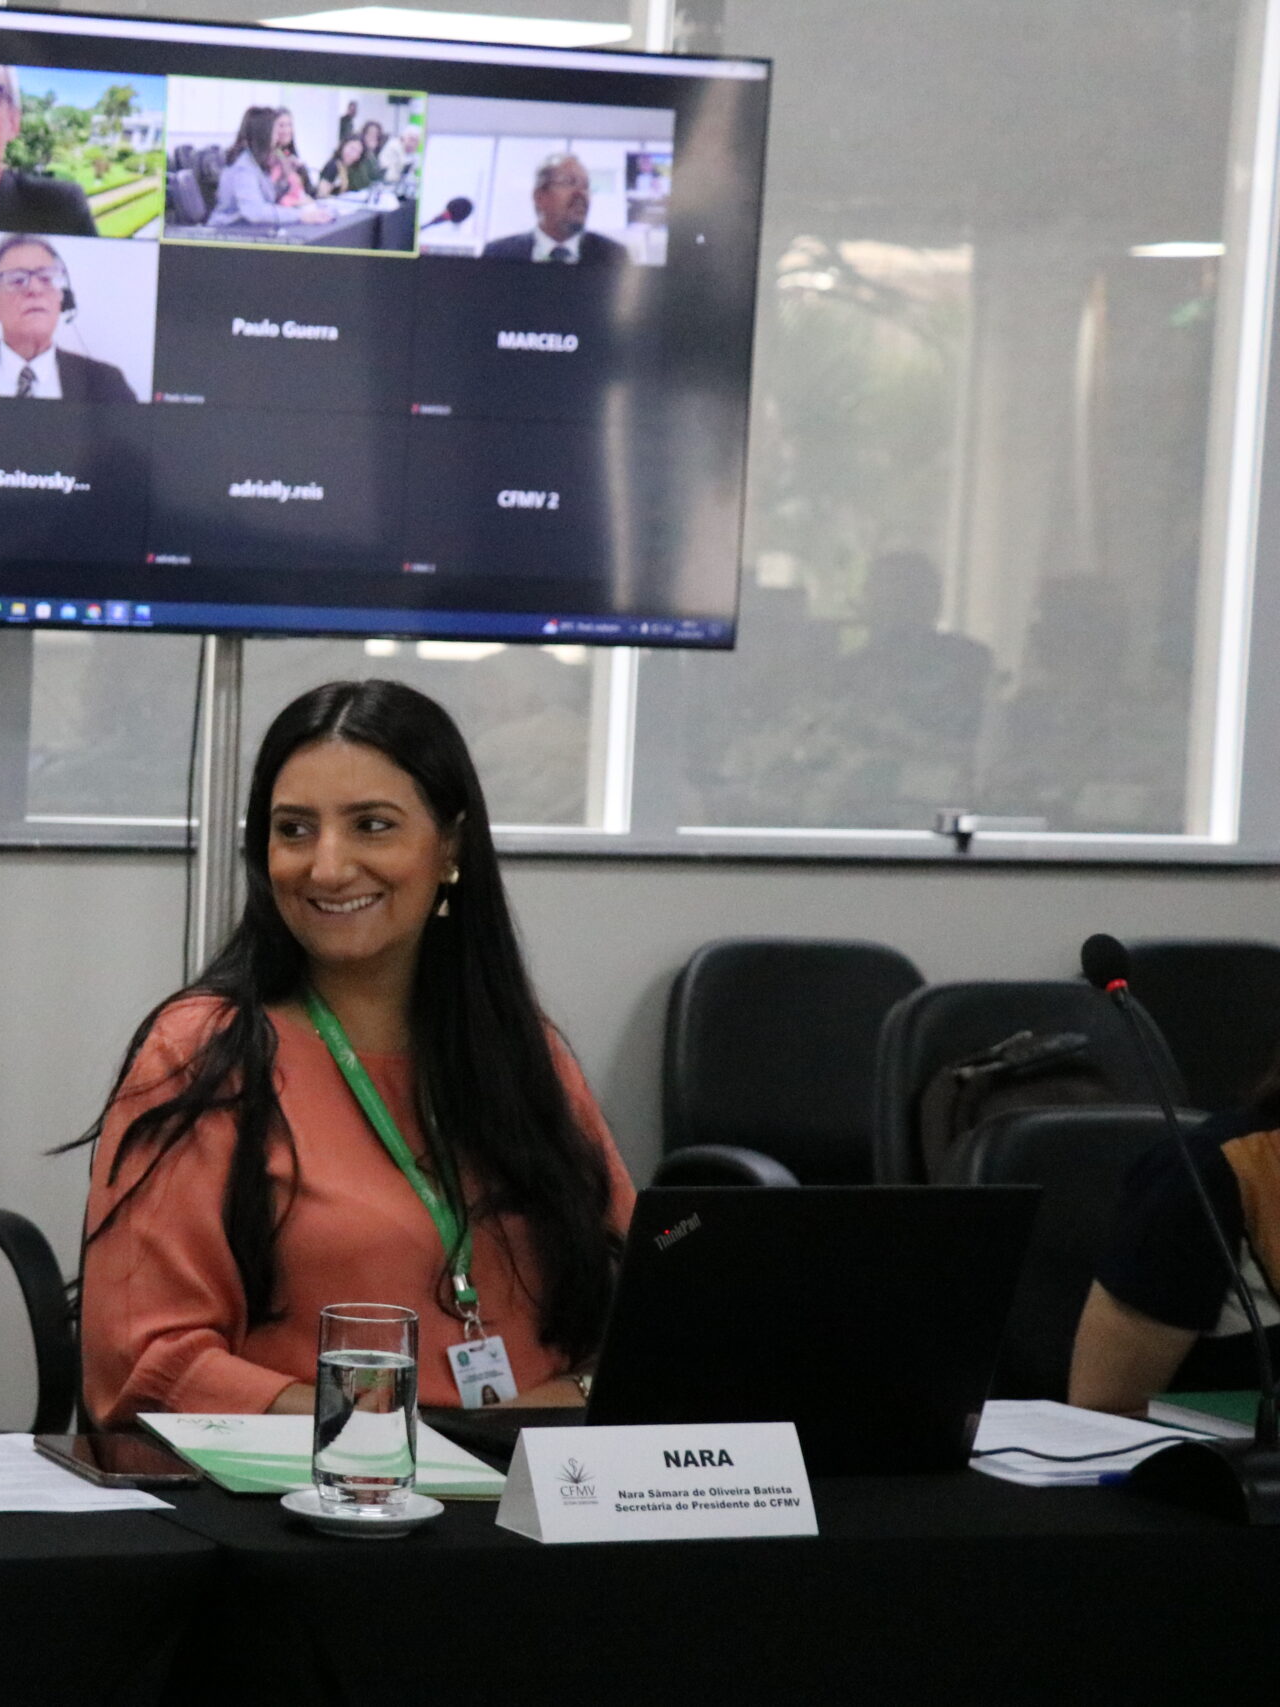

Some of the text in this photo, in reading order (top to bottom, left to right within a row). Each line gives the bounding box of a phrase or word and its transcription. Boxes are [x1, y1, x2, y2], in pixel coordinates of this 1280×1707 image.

[232, 317, 339, 341] Paulo Guerra
[497, 330, 579, 353] MARCELO
[228, 479, 324, 503] adrielly.reis
[497, 489, 560, 510] CFMV 2
[653, 1211, 701, 1251] ThinkPad
[663, 1449, 734, 1468] NARA
[560, 1485, 596, 1497] CFMV
[618, 1490, 645, 1499] Nara
[692, 1488, 706, 1497] de
[708, 1486, 750, 1496] Oliveira
[753, 1485, 792, 1495] Batista
[615, 1497, 801, 1512] Secretária do Presidente do CFMV
